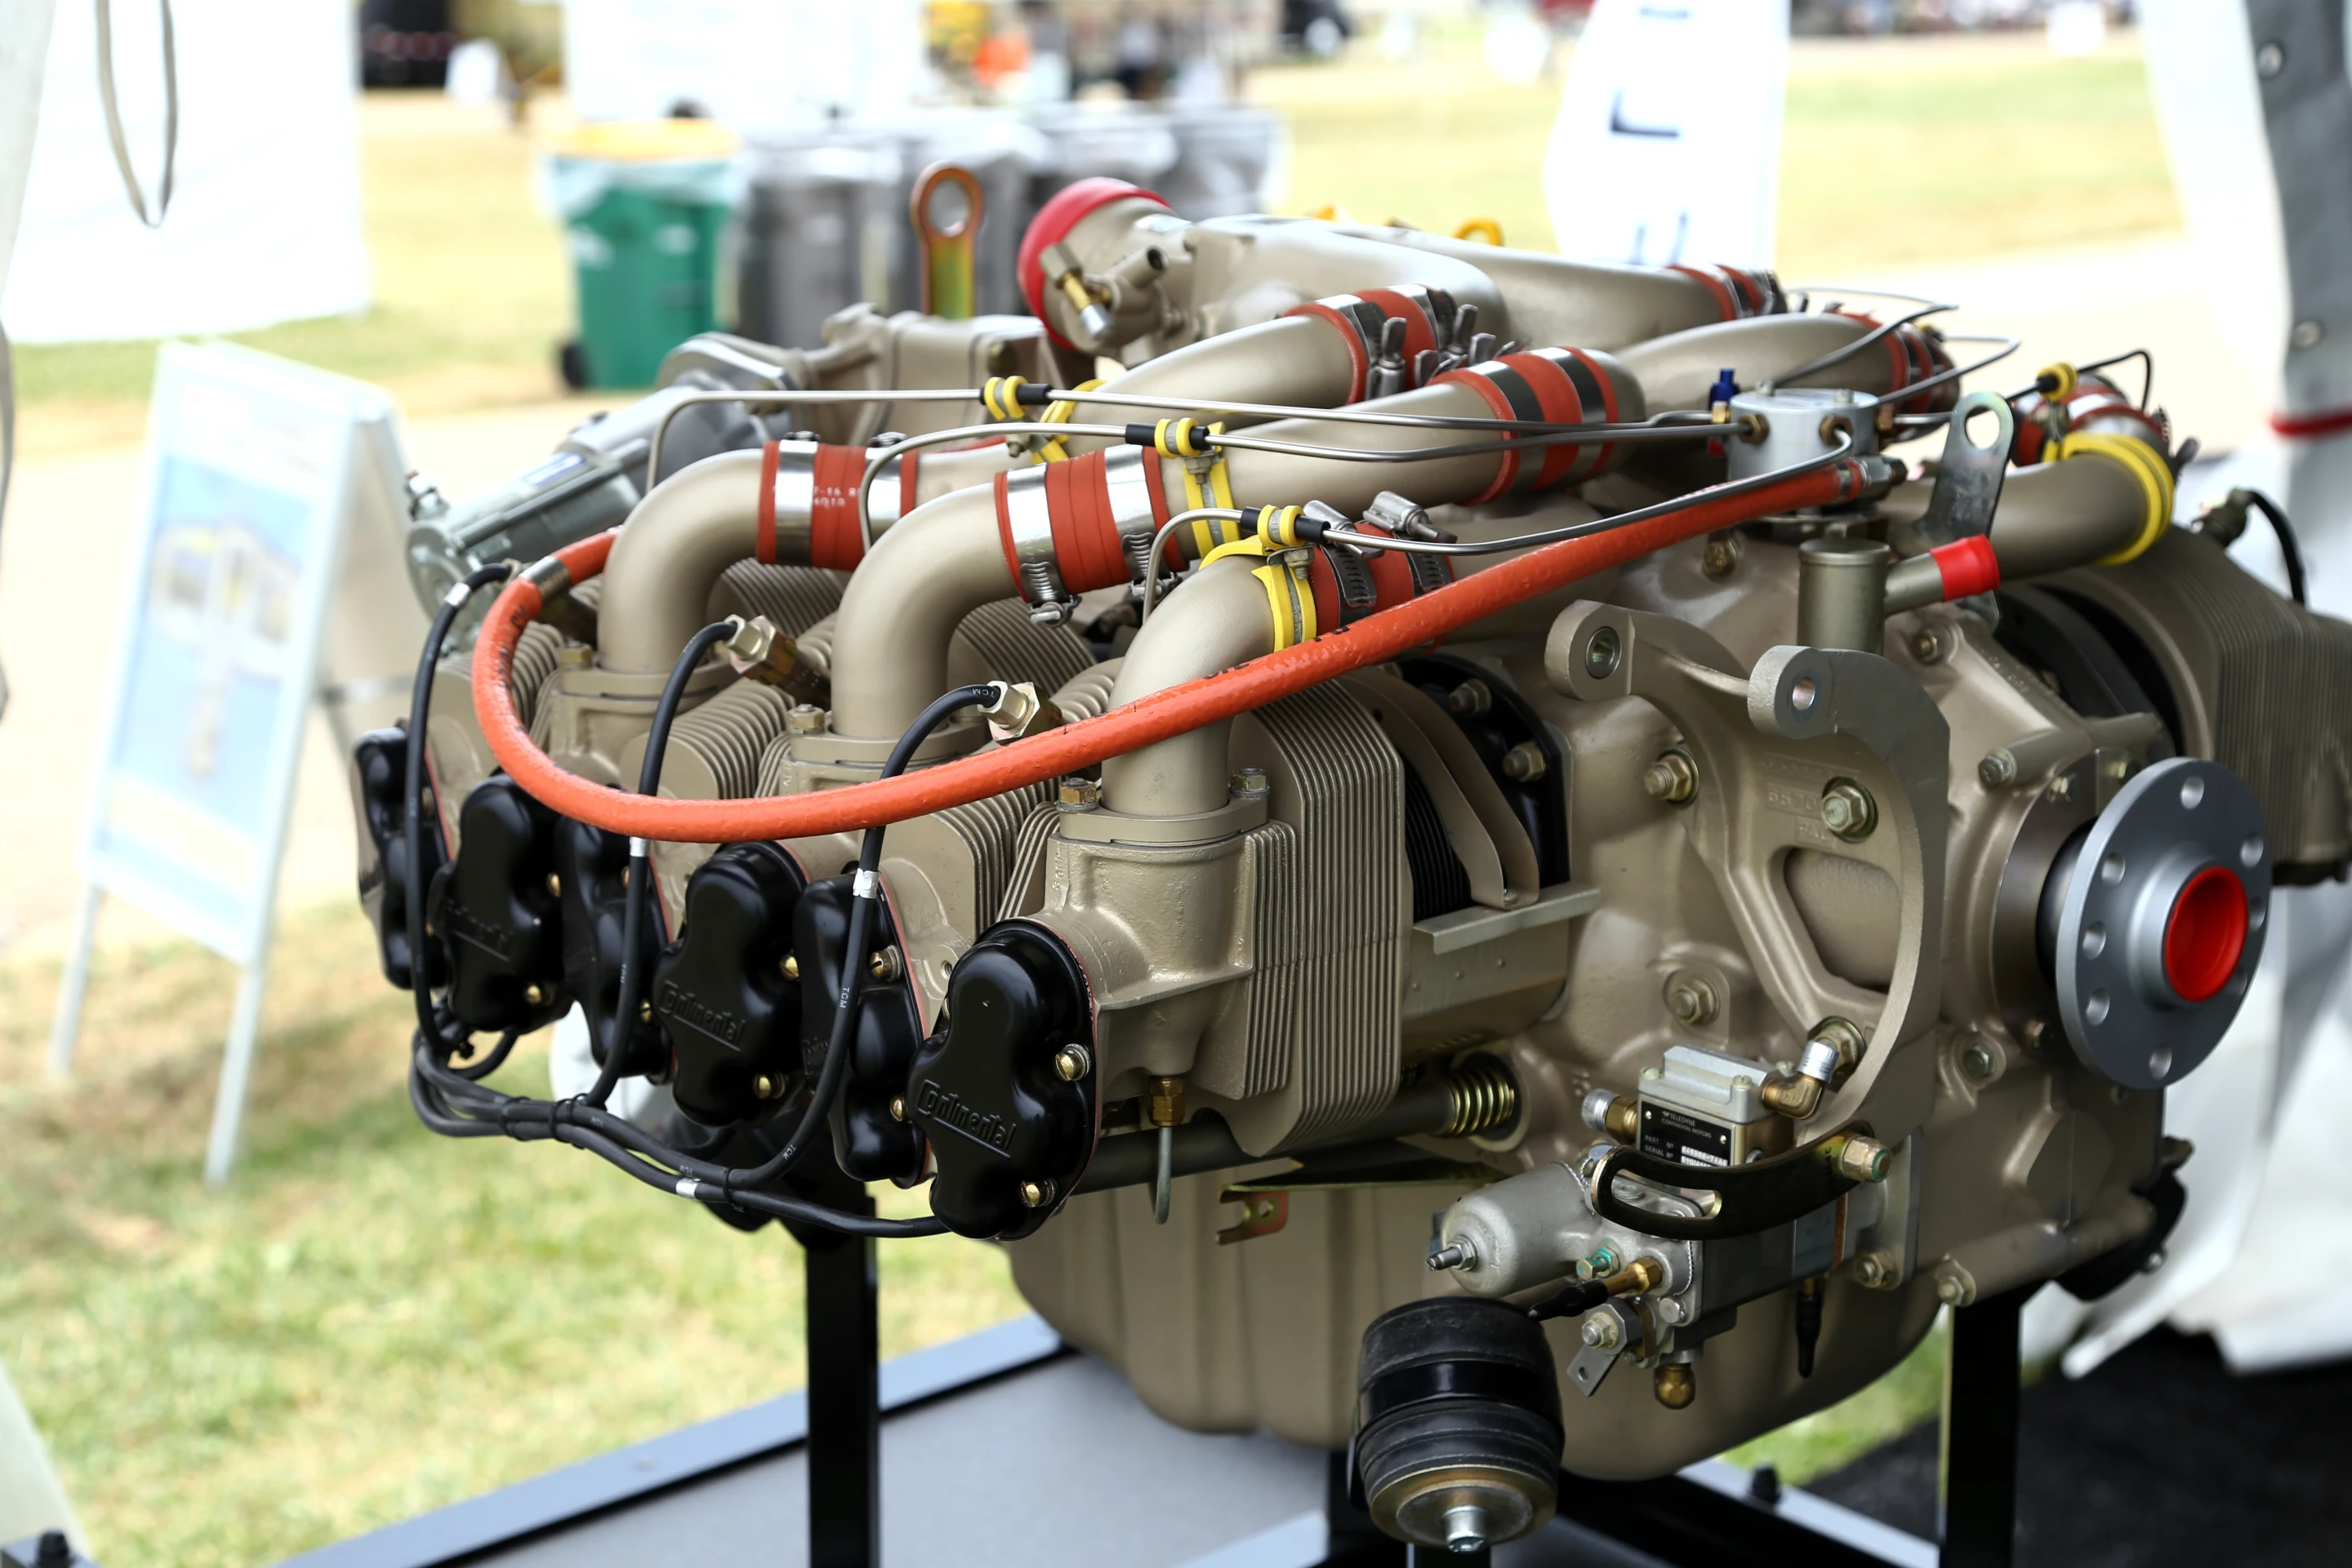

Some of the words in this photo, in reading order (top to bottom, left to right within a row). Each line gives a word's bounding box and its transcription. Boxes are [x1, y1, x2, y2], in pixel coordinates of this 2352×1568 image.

[972, 688, 995, 698] TCM
[840, 987, 850, 1009] TCM
[659, 980, 746, 1046] Continental
[916, 1079, 1018, 1152] Continental
[1670, 1111, 1696, 1127] TELEDYNE
[1661, 1118, 1692, 1133] CONTINENTAL
[1692, 1128, 1713, 1139] MOTORS
[1645, 1135, 1660, 1144] PART
[782, 1144, 797, 1160] TCM
[1645, 1145, 1664, 1156] SERIAL
